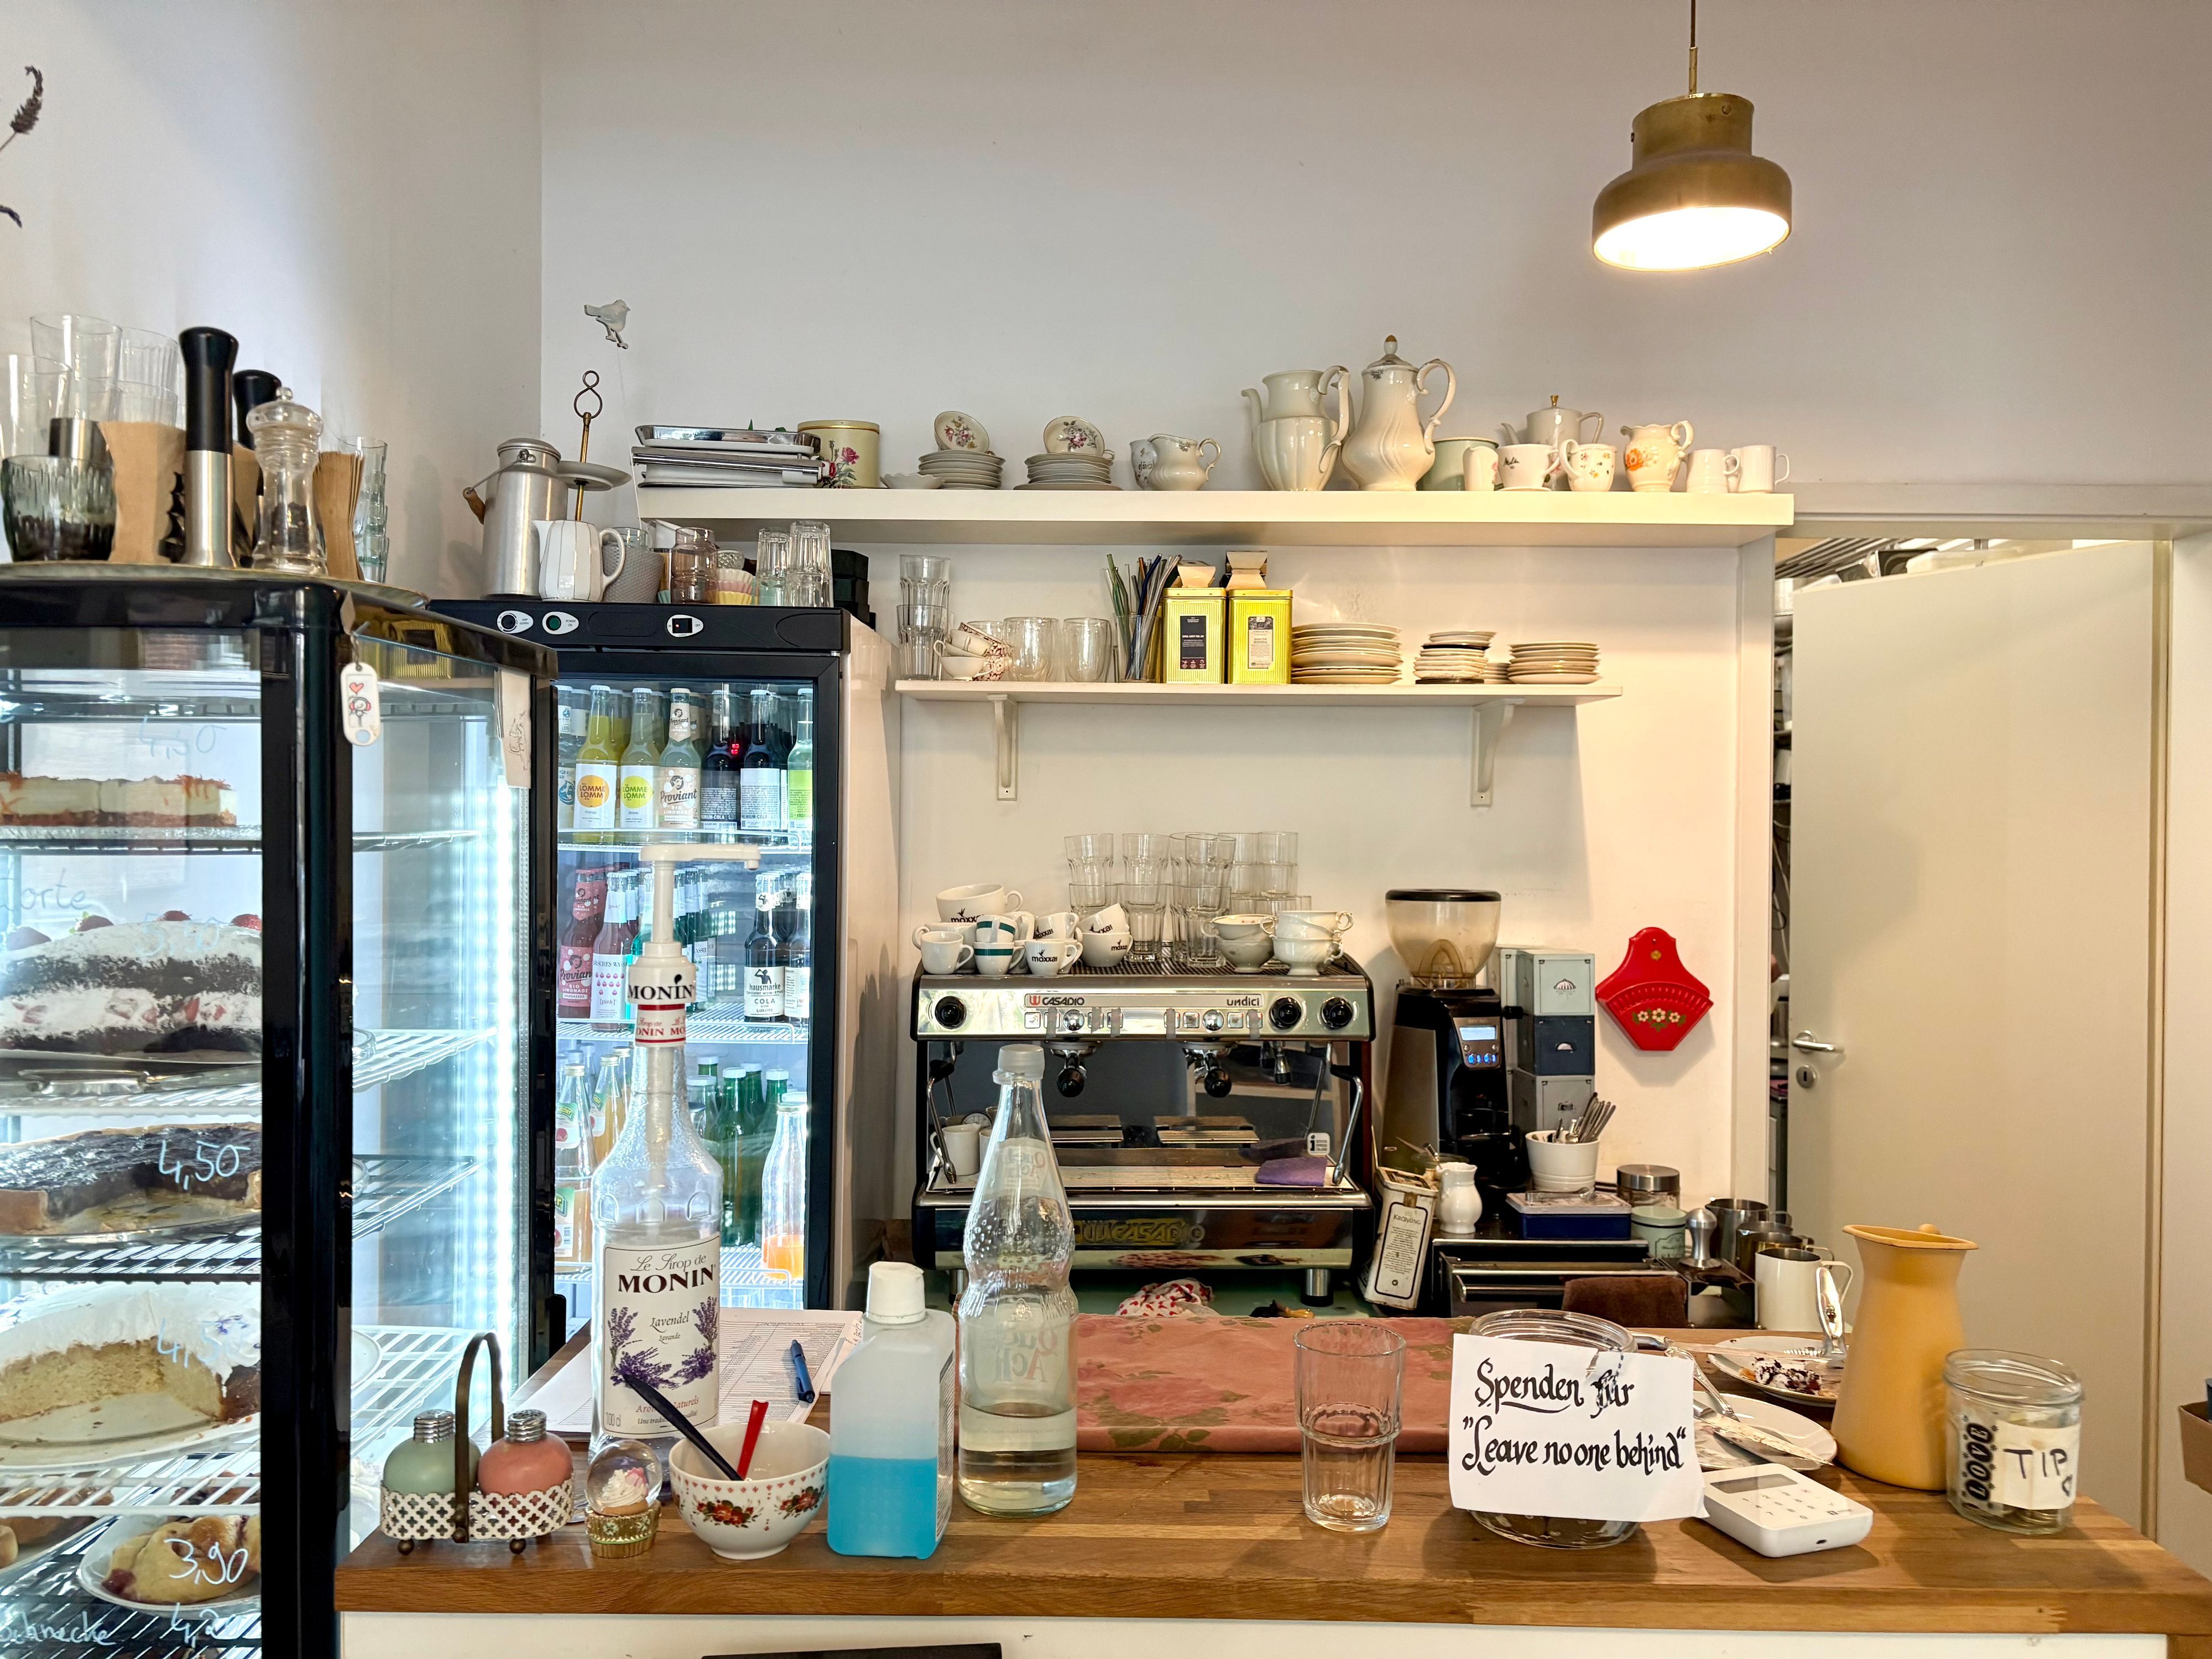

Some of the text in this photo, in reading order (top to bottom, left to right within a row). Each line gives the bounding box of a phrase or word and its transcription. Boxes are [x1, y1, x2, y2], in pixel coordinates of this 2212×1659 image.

[660, 789, 697, 804] Proviant
[560, 969, 592, 980] Provian
[628, 984, 693, 1000] MONIN
[749, 982, 781, 991] hausmarke
[1042, 997, 1085, 1006] CASADIO
[1227, 996, 1260, 1006] undici
[637, 1028, 665, 1036] ONIN
[159, 1140, 252, 1190] 4,50
[630, 1253, 707, 1272] Le Sirop de
[618, 1266, 715, 1294] MONIN
[649, 1311, 690, 1333] Lavendel
[658, 1332, 681, 1344] Lavande
[1475, 1358, 1584, 1414] Spenden
[674, 1395, 700, 1409] aturels
[1965, 1423, 1994, 1501] LOVE
[2003, 1448, 2068, 1479] TIP
[164, 1539, 248, 1585] 3,90
